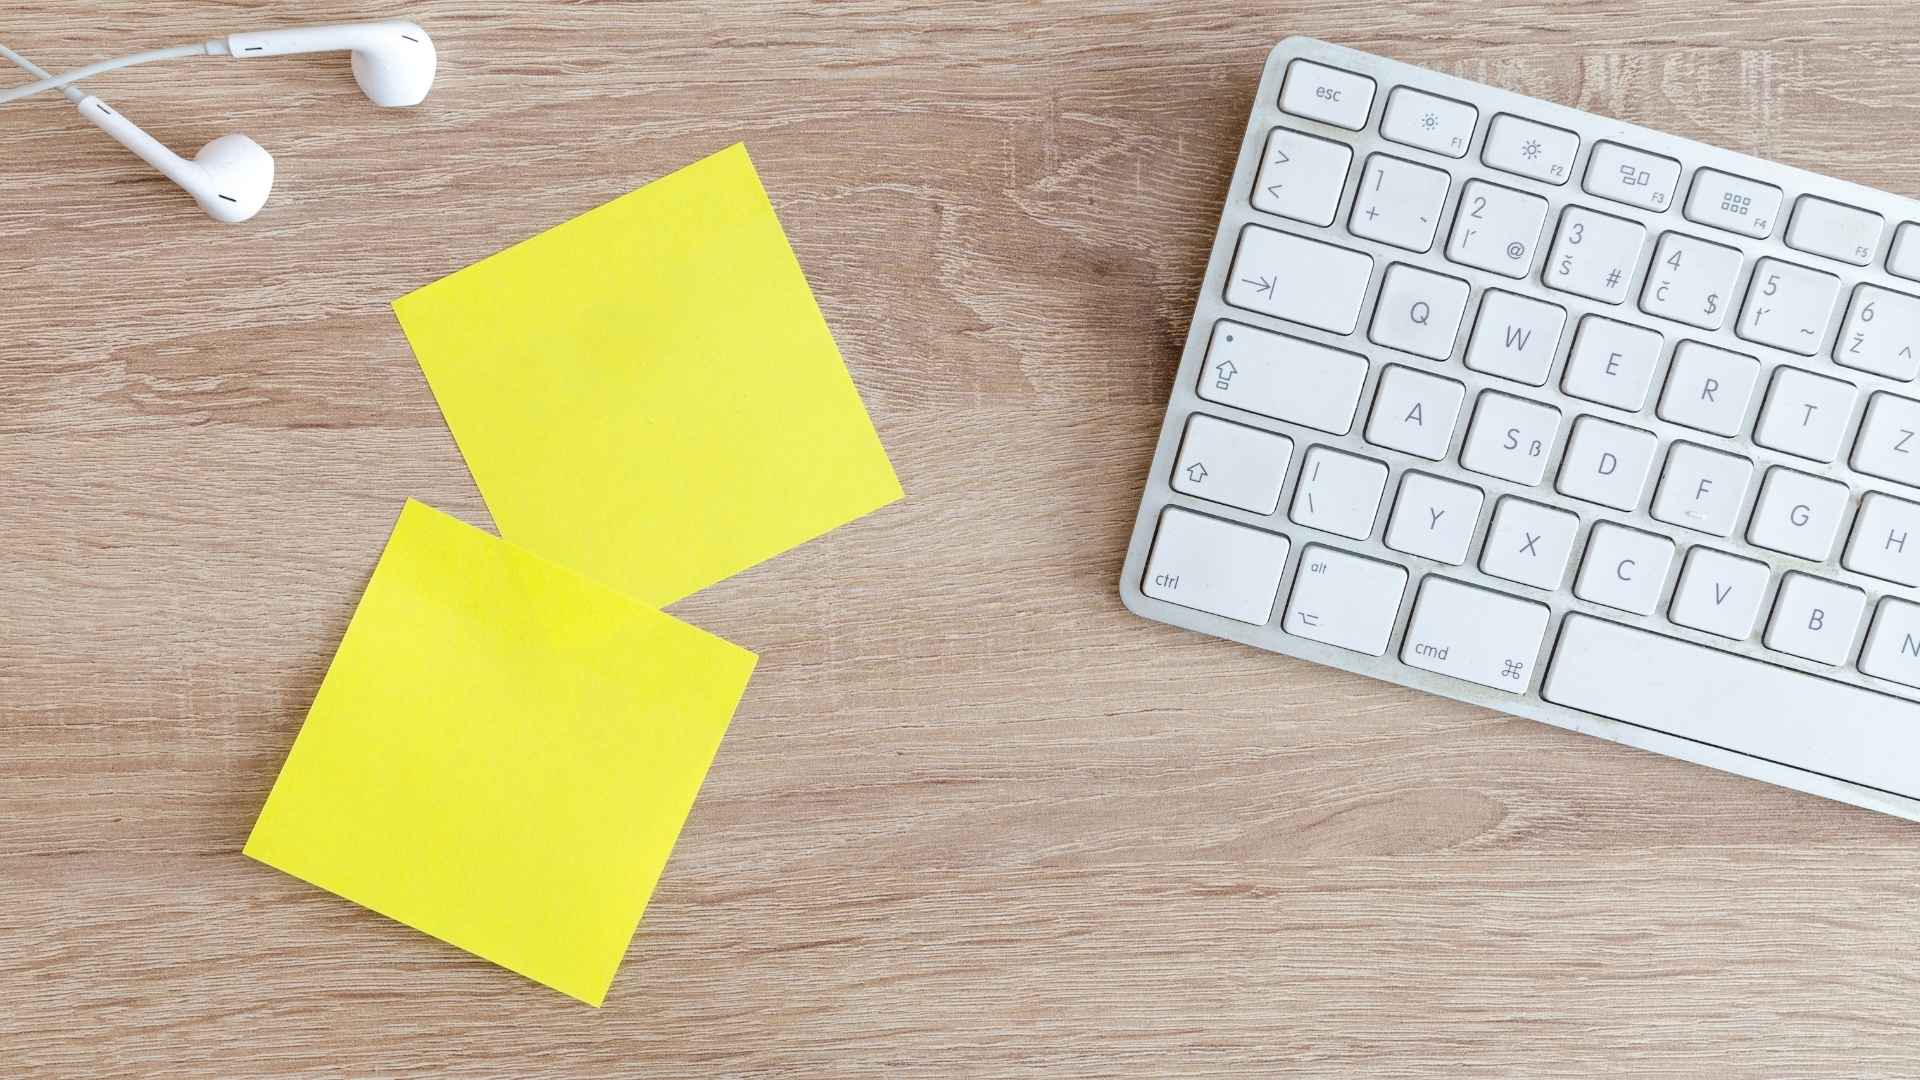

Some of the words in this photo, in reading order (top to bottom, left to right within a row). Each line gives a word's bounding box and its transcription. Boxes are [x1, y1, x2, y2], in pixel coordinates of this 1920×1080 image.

[1316, 87, 1341, 102] esc
[1451, 137, 1463, 149] F1
[1275, 150, 1289, 164] >
[1376, 170, 1384, 191] 1
[1551, 165, 1564, 177] F2
[1268, 185, 1282, 198] <
[1652, 192, 1665, 204] F3
[1366, 207, 1379, 220] +
[1471, 197, 1486, 219] 2
[1569, 224, 1584, 244] 3
[1753, 218, 1767, 230] F4
[1507, 242, 1524, 259] @
[1667, 250, 1682, 271] 4
[1606, 269, 1621, 288] #
[1763, 275, 1780, 296] 5
[1410, 302, 1429, 325] Q
[1704, 294, 1718, 314] $
[1861, 302, 1875, 322] 6
[1506, 326, 1531, 351] W
[1800, 328, 1815, 336] ~
[1606, 353, 1622, 376] E
[1702, 379, 1719, 402] R
[1405, 403, 1422, 426] A
[1803, 404, 1817, 426] T
[1504, 429, 1520, 450] S
[1894, 429, 1914, 453] Z
[1598, 453, 1616, 475] D
[1696, 479, 1712, 499] F
[1430, 508, 1445, 529] Y
[1791, 505, 1810, 526] G
[1520, 532, 1540, 556] X
[1885, 529, 1907, 552] H
[1312, 563, 1326, 574] alt
[1617, 560, 1635, 581] C
[1156, 575, 1179, 589] ctrl
[1716, 583, 1732, 605] V
[1808, 609, 1824, 631] B
[1416, 644, 1448, 660] cmd
